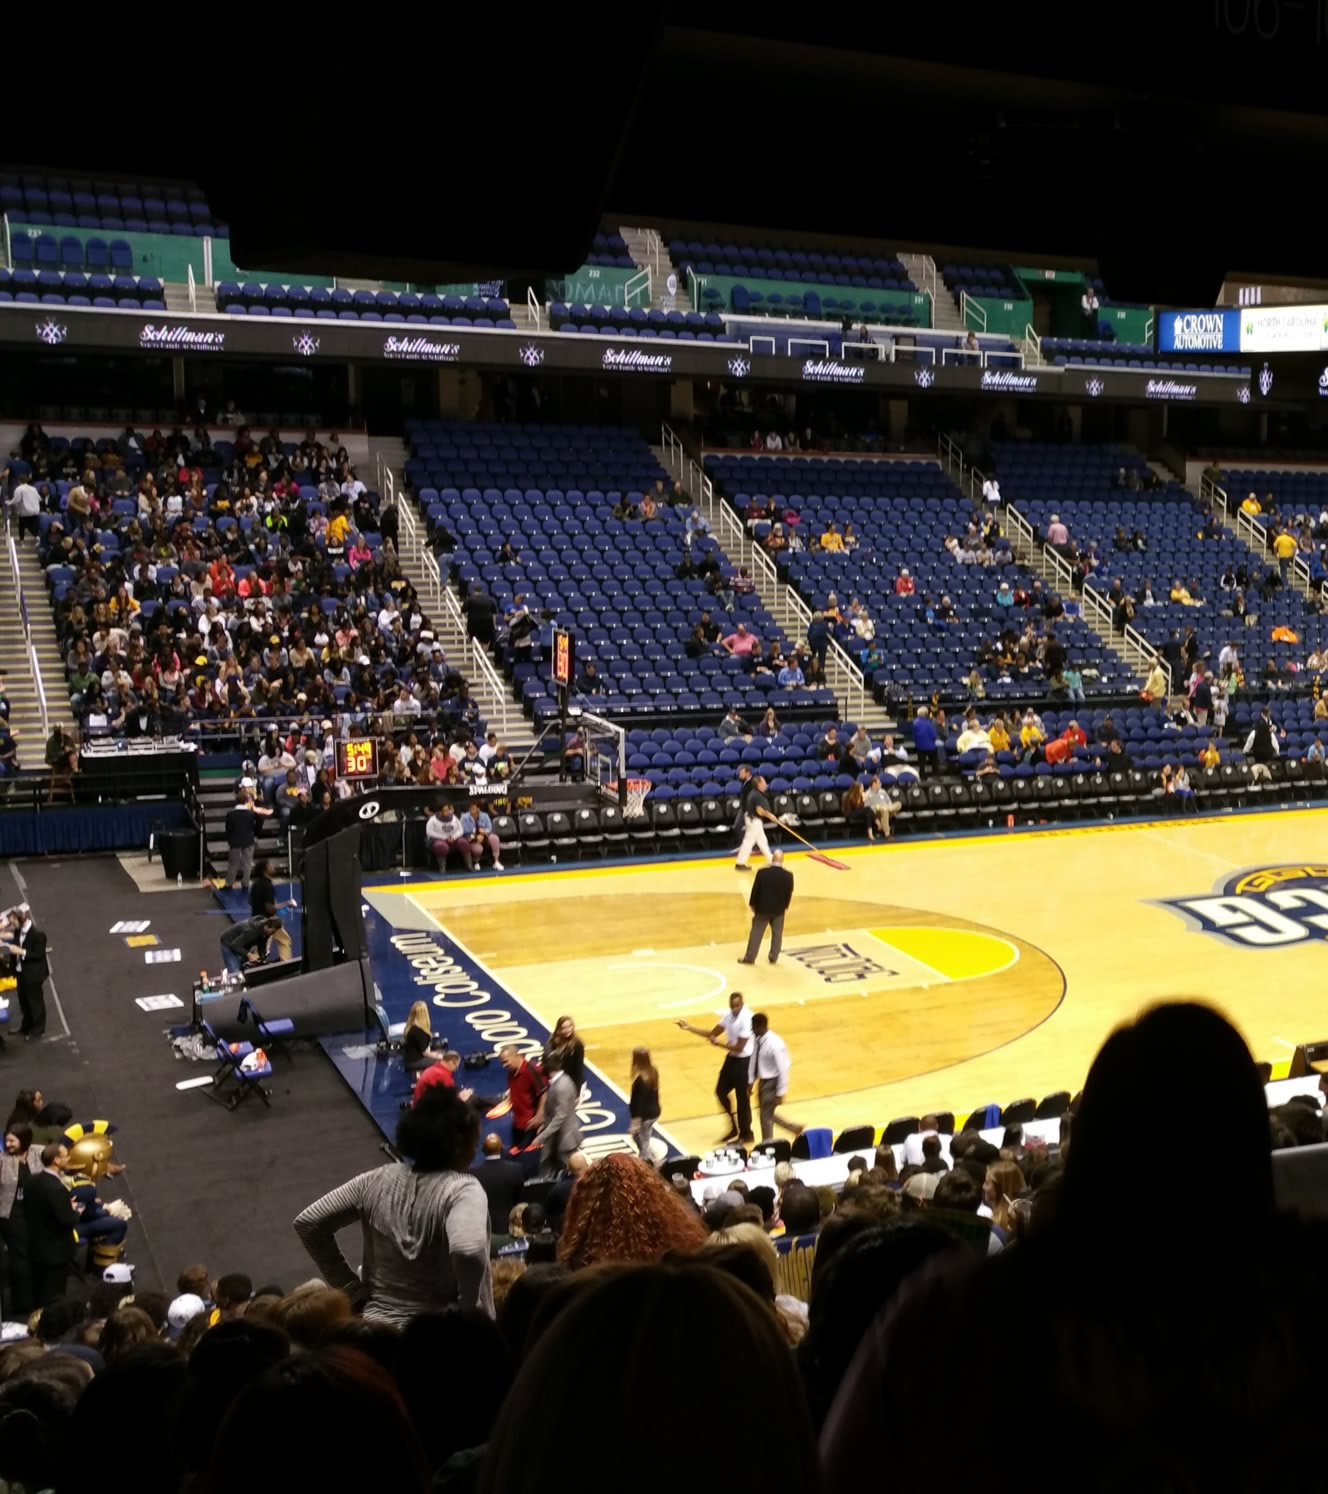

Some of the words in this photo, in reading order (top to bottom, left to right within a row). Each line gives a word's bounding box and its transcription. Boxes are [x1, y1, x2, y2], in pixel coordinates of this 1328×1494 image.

[1183, 314, 1224, 334] CROWN
[139, 323, 225, 343] Schillman's
[1173, 333, 1224, 350] AUTOMOTIVE
[384, 336, 460, 354] Schillman's
[602, 349, 672, 366] Schillman's
[802, 360, 864, 377] Schillman's
[981, 371, 1038, 388] Schillman's
[1146, 379, 1197, 395] Schillman's
[347, 756, 367, 772] 30
[469, 784, 508, 796] SPALDING
[390, 932, 491, 1008] Coliseum
